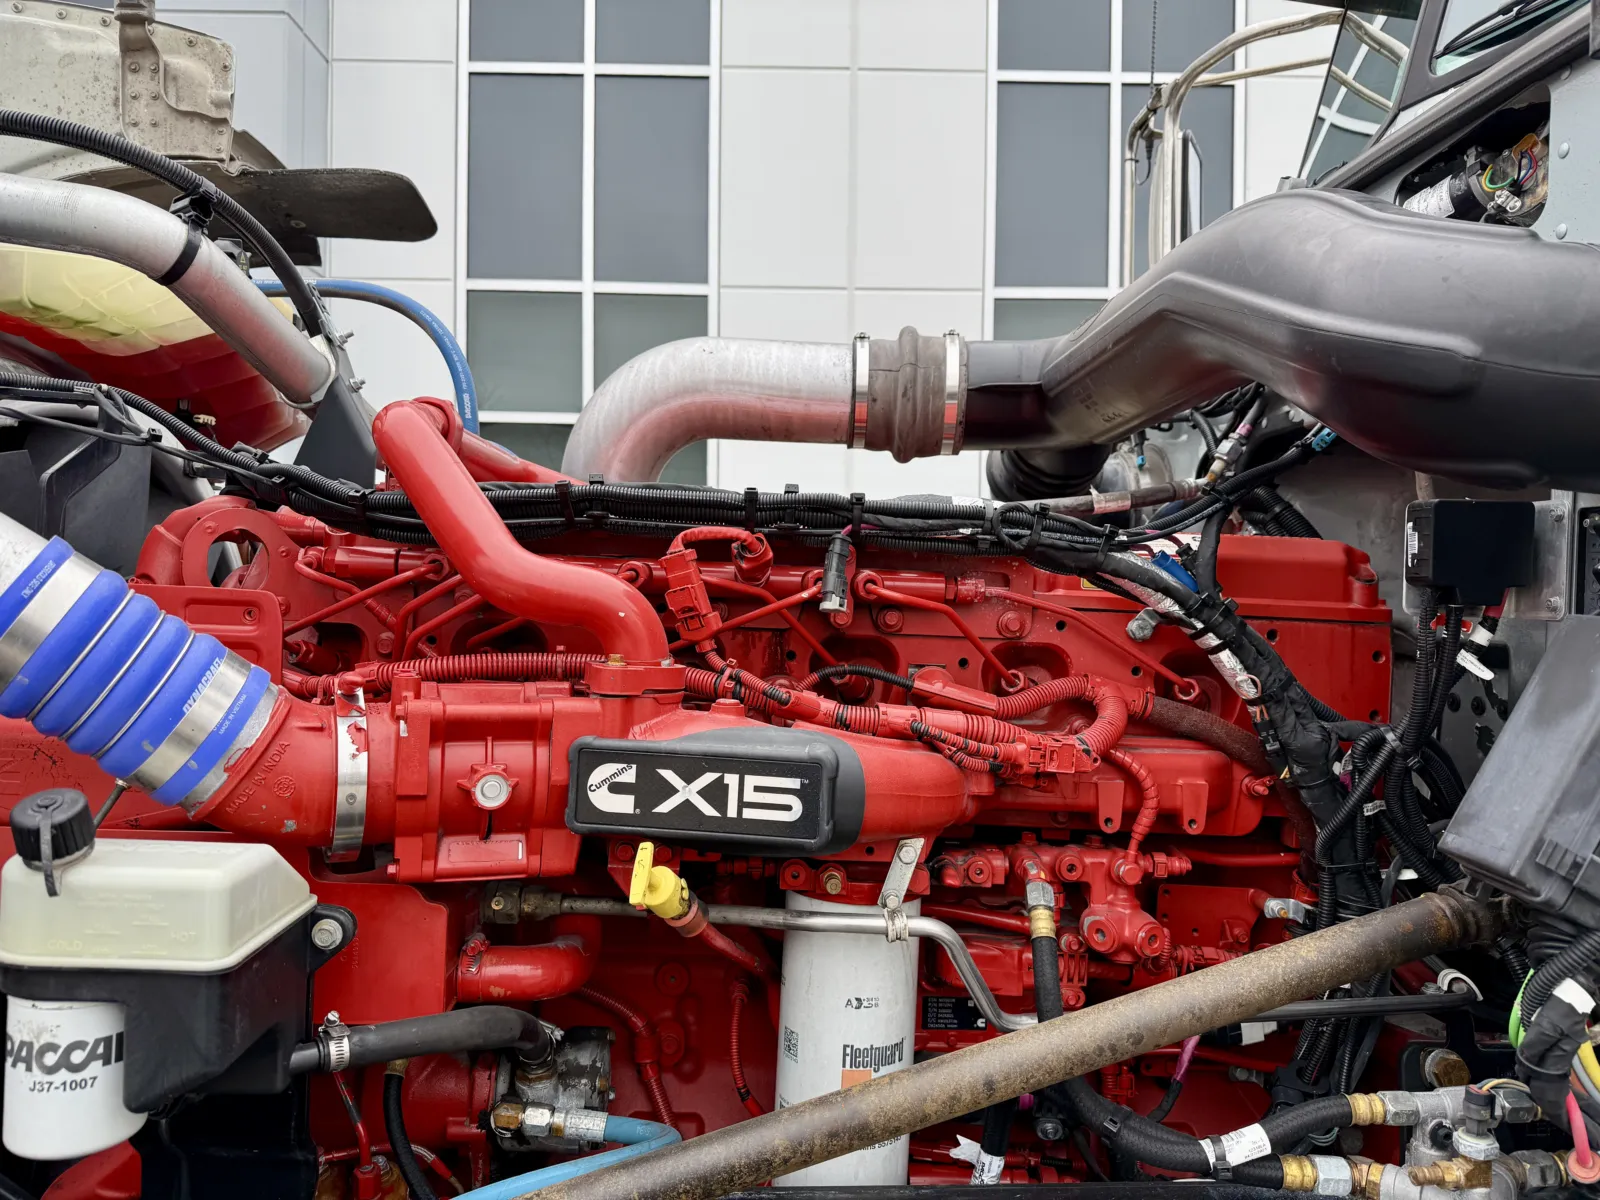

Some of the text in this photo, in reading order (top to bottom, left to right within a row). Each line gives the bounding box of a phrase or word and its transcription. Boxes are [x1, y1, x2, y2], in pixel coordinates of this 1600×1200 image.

[231, 693, 247, 714] VIETNAM
[228, 713, 236, 721] IN
[218, 719, 231, 735] MADE
[225, 786, 256, 815] MADE
[251, 771, 267, 787] IN
[261, 741, 291, 774] INDIA
[588, 763, 633, 794] Cummins
[651, 768, 803, 823] X15
[47, 939, 83, 951] COLD
[170, 930, 197, 942] HOT
[842, 1038, 904, 1073] Fleetguard
[29, 1076, 98, 1093] J37-1007
